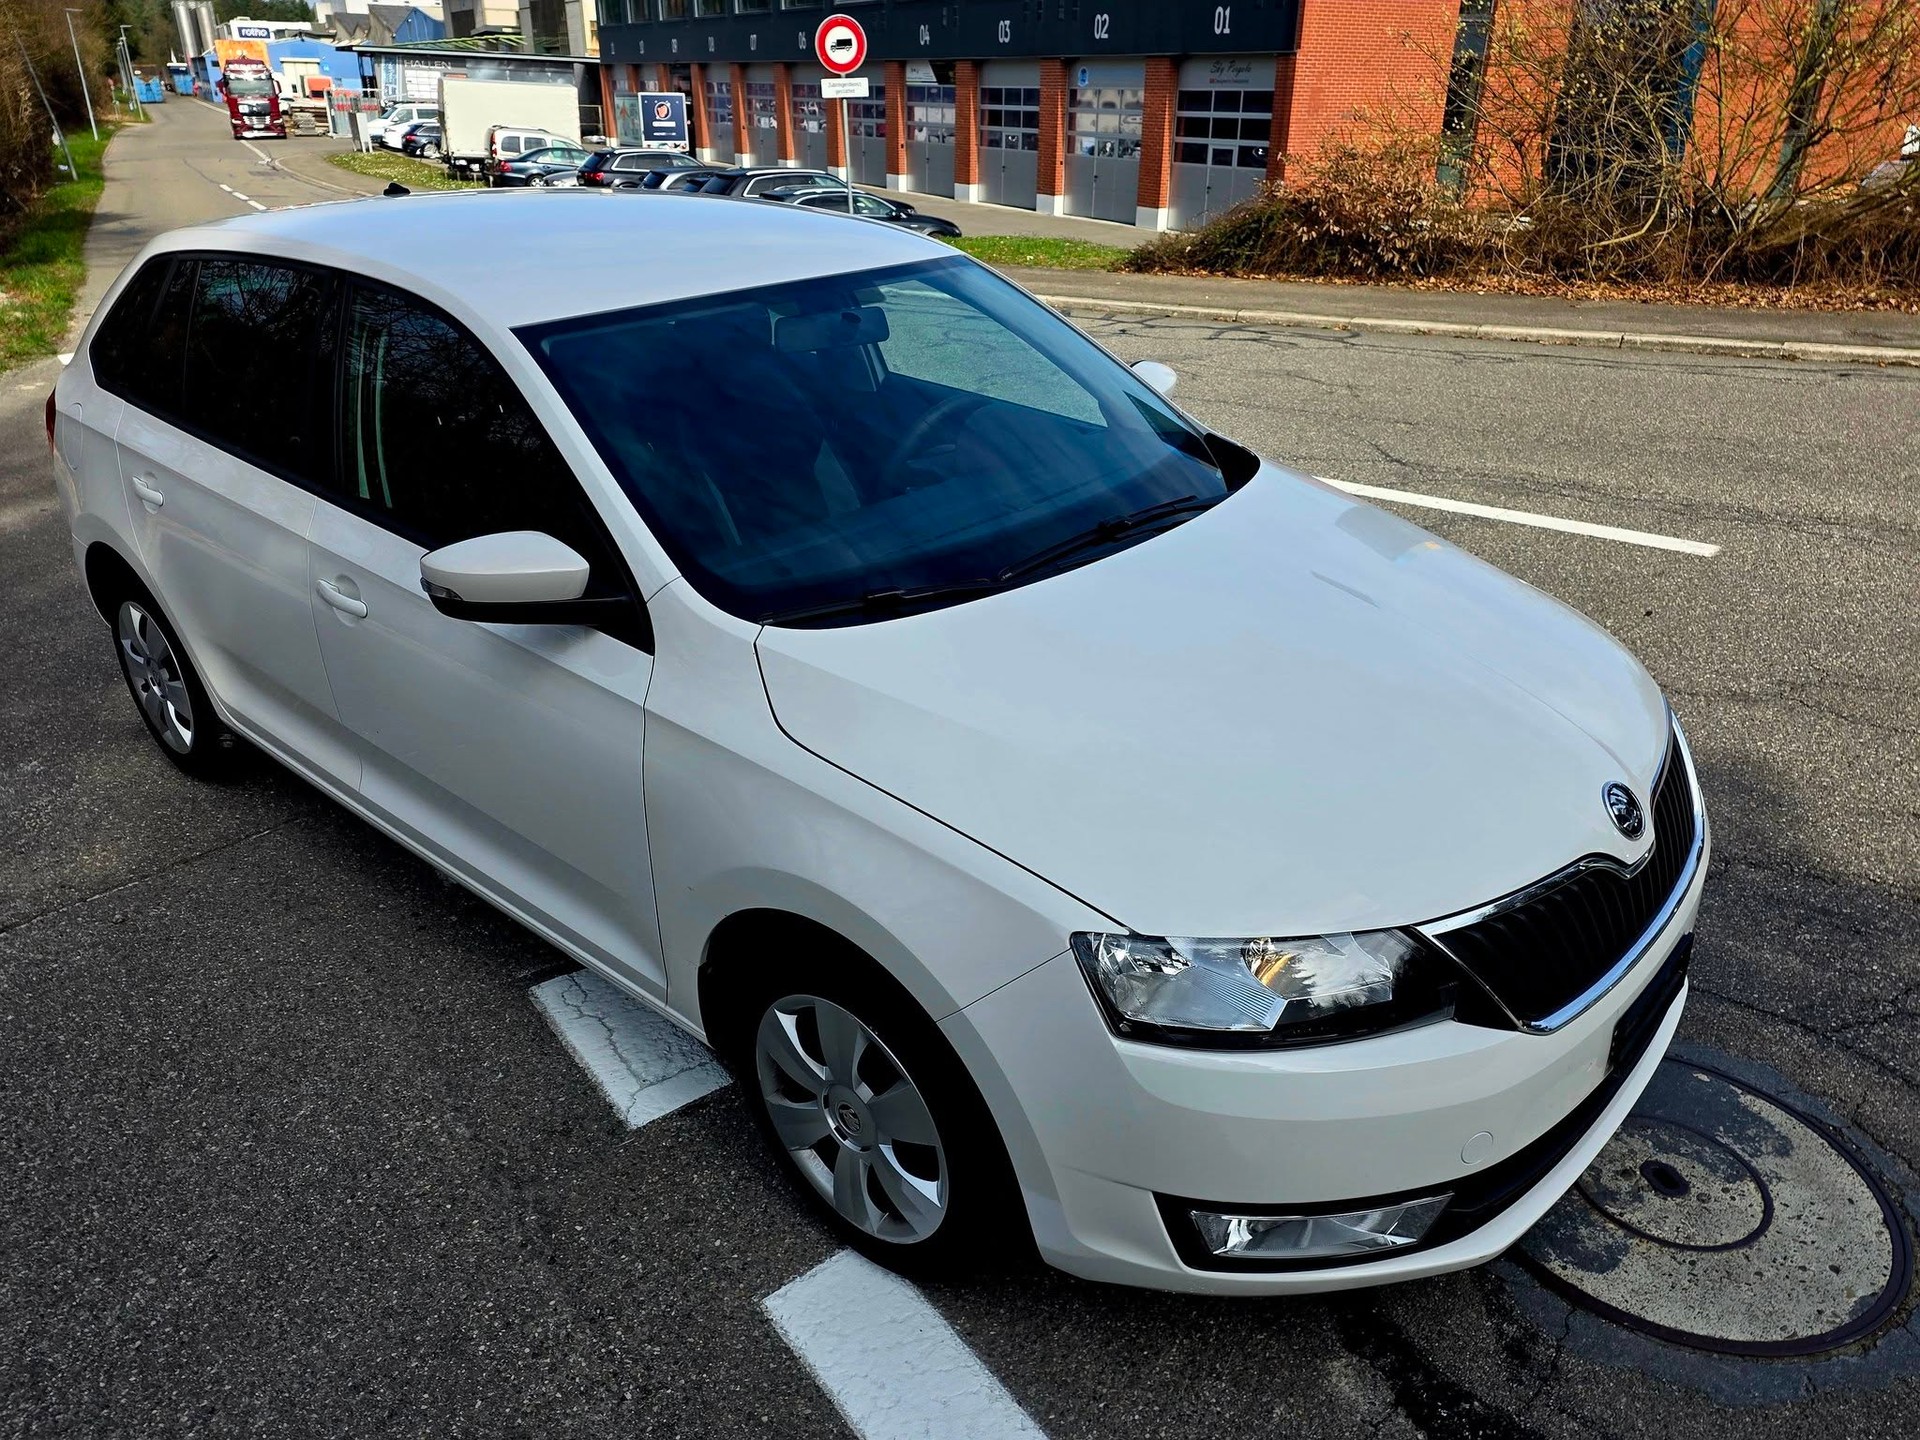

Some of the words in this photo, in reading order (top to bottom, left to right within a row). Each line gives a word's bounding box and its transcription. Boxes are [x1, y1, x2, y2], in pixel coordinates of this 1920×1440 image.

[998, 20, 1011, 43] 03
[1094, 13, 1109, 39] 02
[1214, 6, 1231, 35] 01
[919, 24, 930, 46] 04
[403, 59, 452, 70] HALLEN
